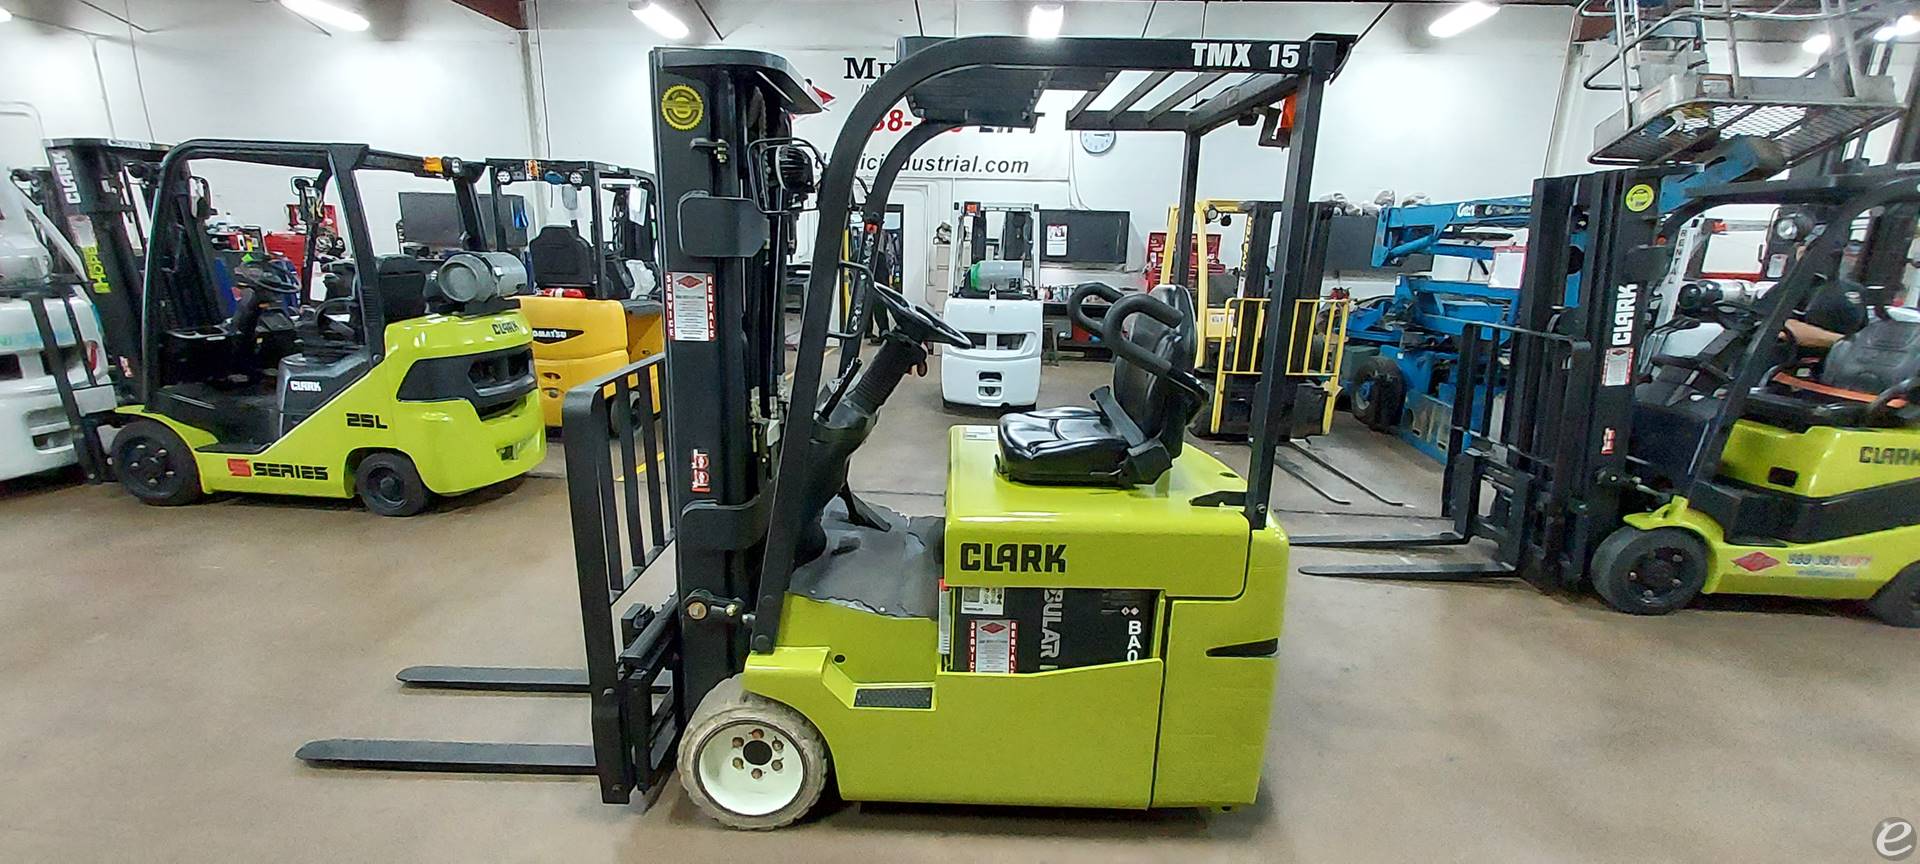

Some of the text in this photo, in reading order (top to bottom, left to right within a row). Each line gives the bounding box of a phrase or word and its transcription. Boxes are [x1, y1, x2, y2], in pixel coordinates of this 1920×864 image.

[1191, 42, 1301, 69] TMX 15
[52, 150, 81, 204] CLARK
[665, 274, 674, 337] SERVICE
[707, 275, 716, 338] RENTALS
[1612, 283, 1638, 346] CLARK
[492, 321, 519, 335] CLARK
[532, 329, 567, 338] OMATSU
[289, 380, 321, 392] CLARK
[346, 413, 388, 429] 25L
[253, 462, 328, 480] SERIES
[960, 543, 1066, 573] CLARK
[1040, 589, 1064, 659] BULAR
